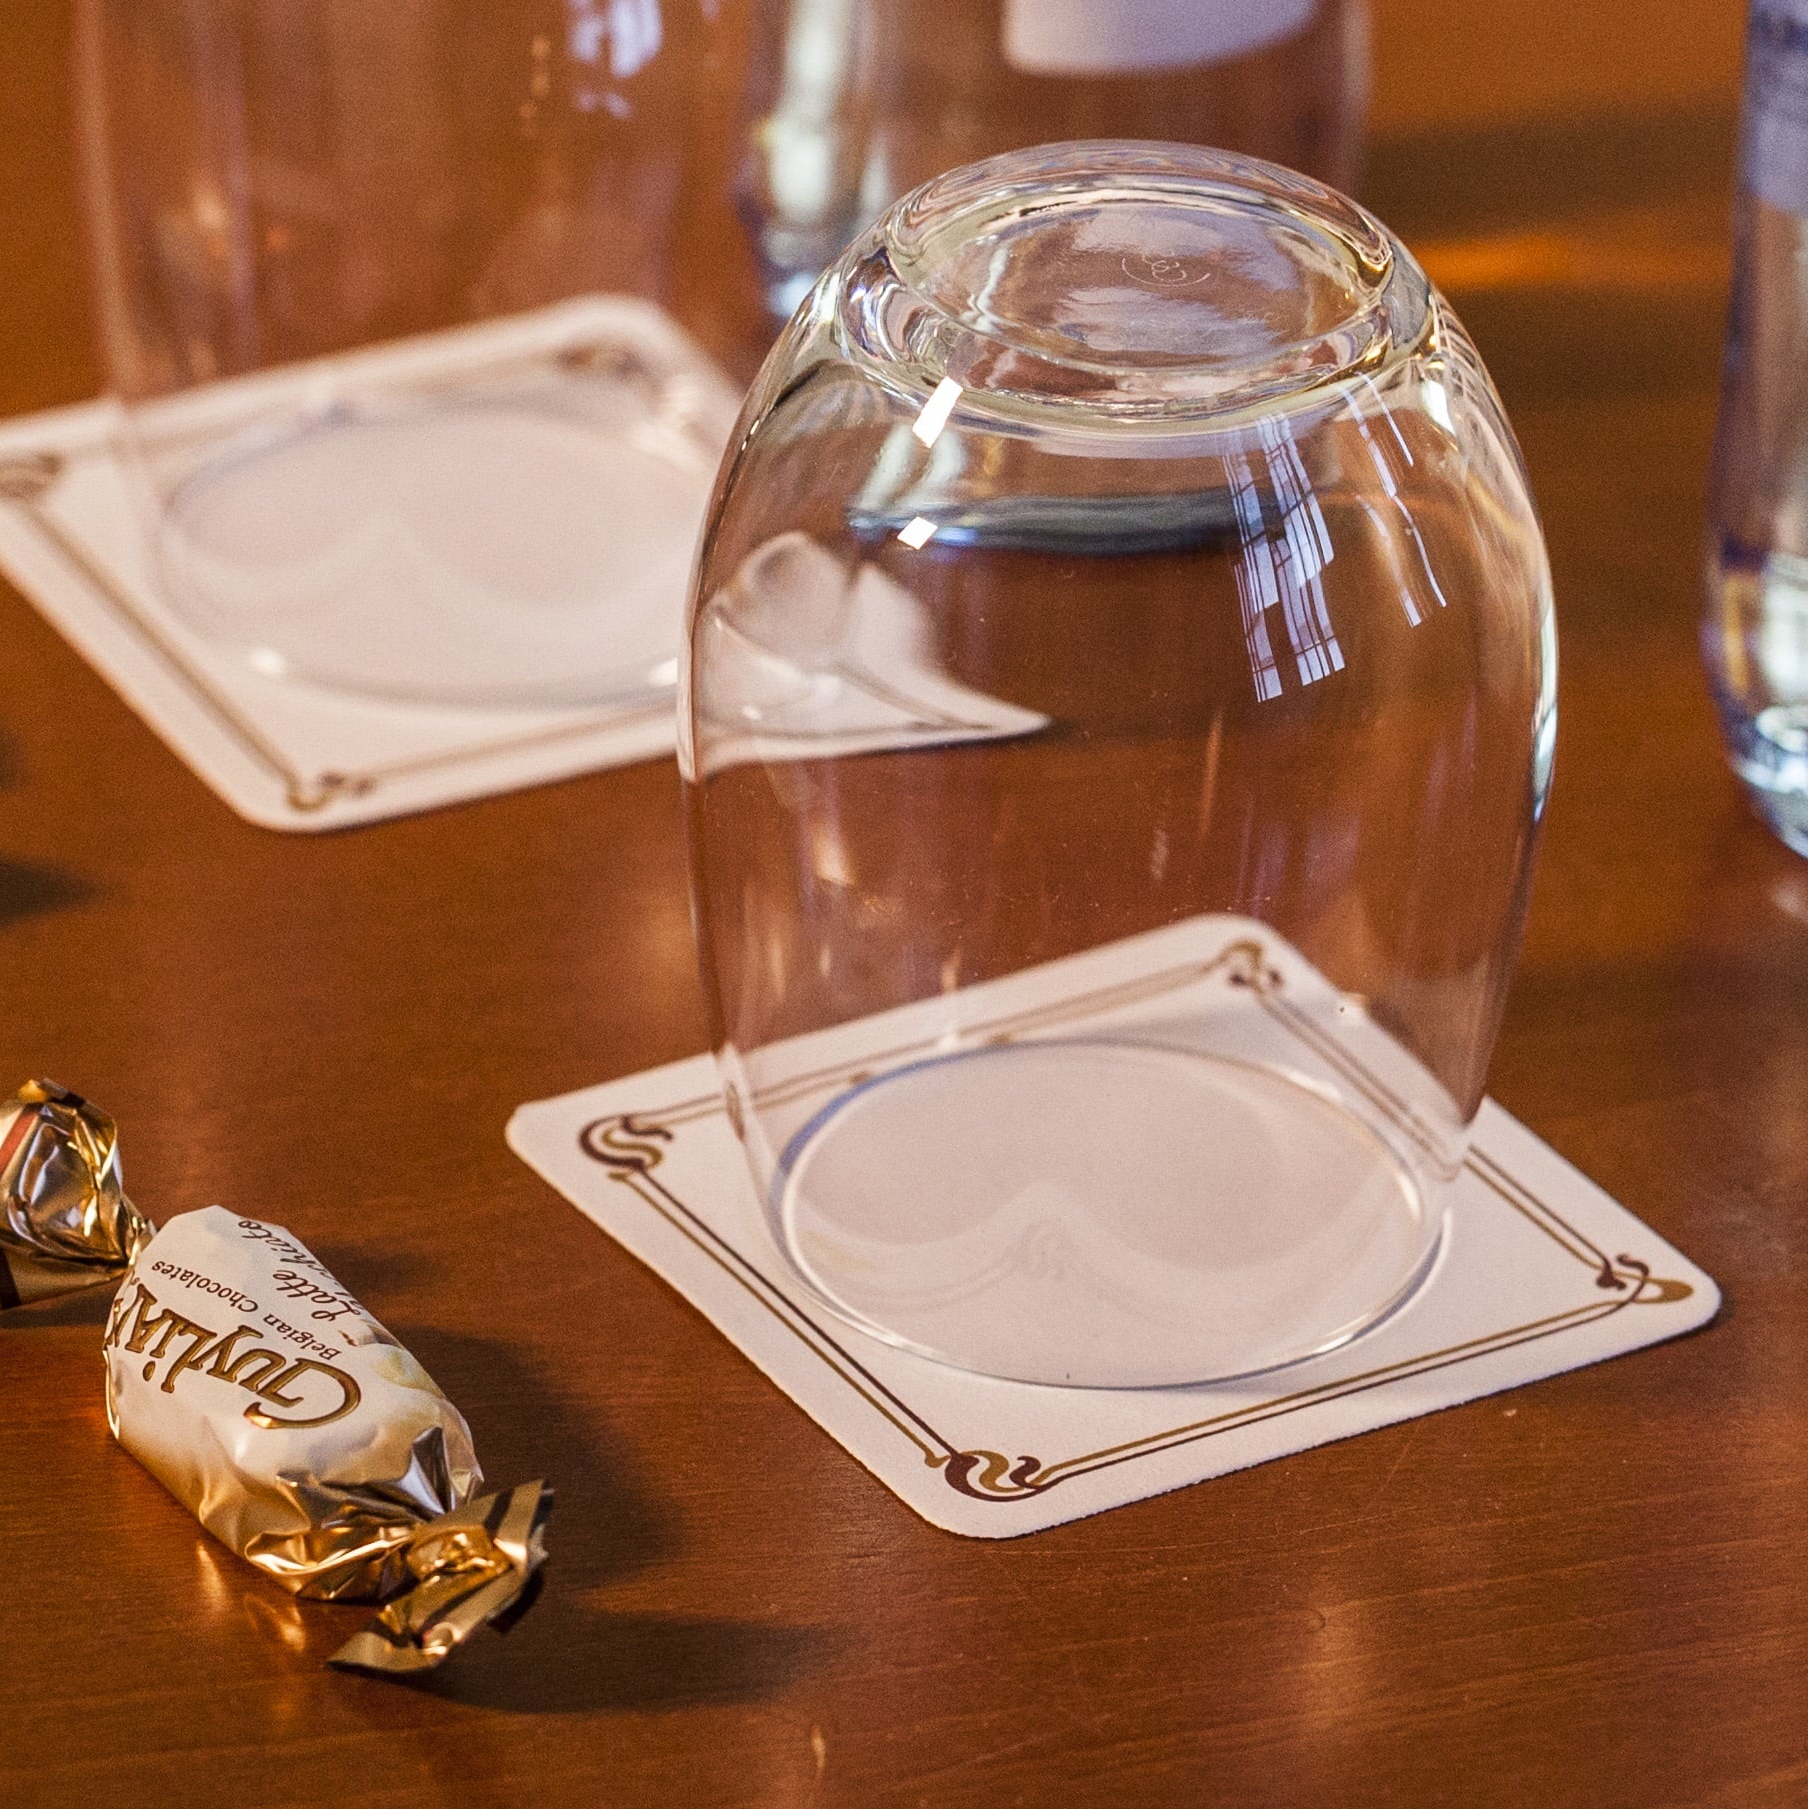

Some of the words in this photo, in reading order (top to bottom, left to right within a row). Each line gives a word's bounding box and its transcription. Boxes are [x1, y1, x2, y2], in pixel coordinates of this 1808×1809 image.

[150, 1259, 260, 1314] Chocolates
[271, 1268, 363, 1322] Latte
[262, 1312, 343, 1361] Belgian
